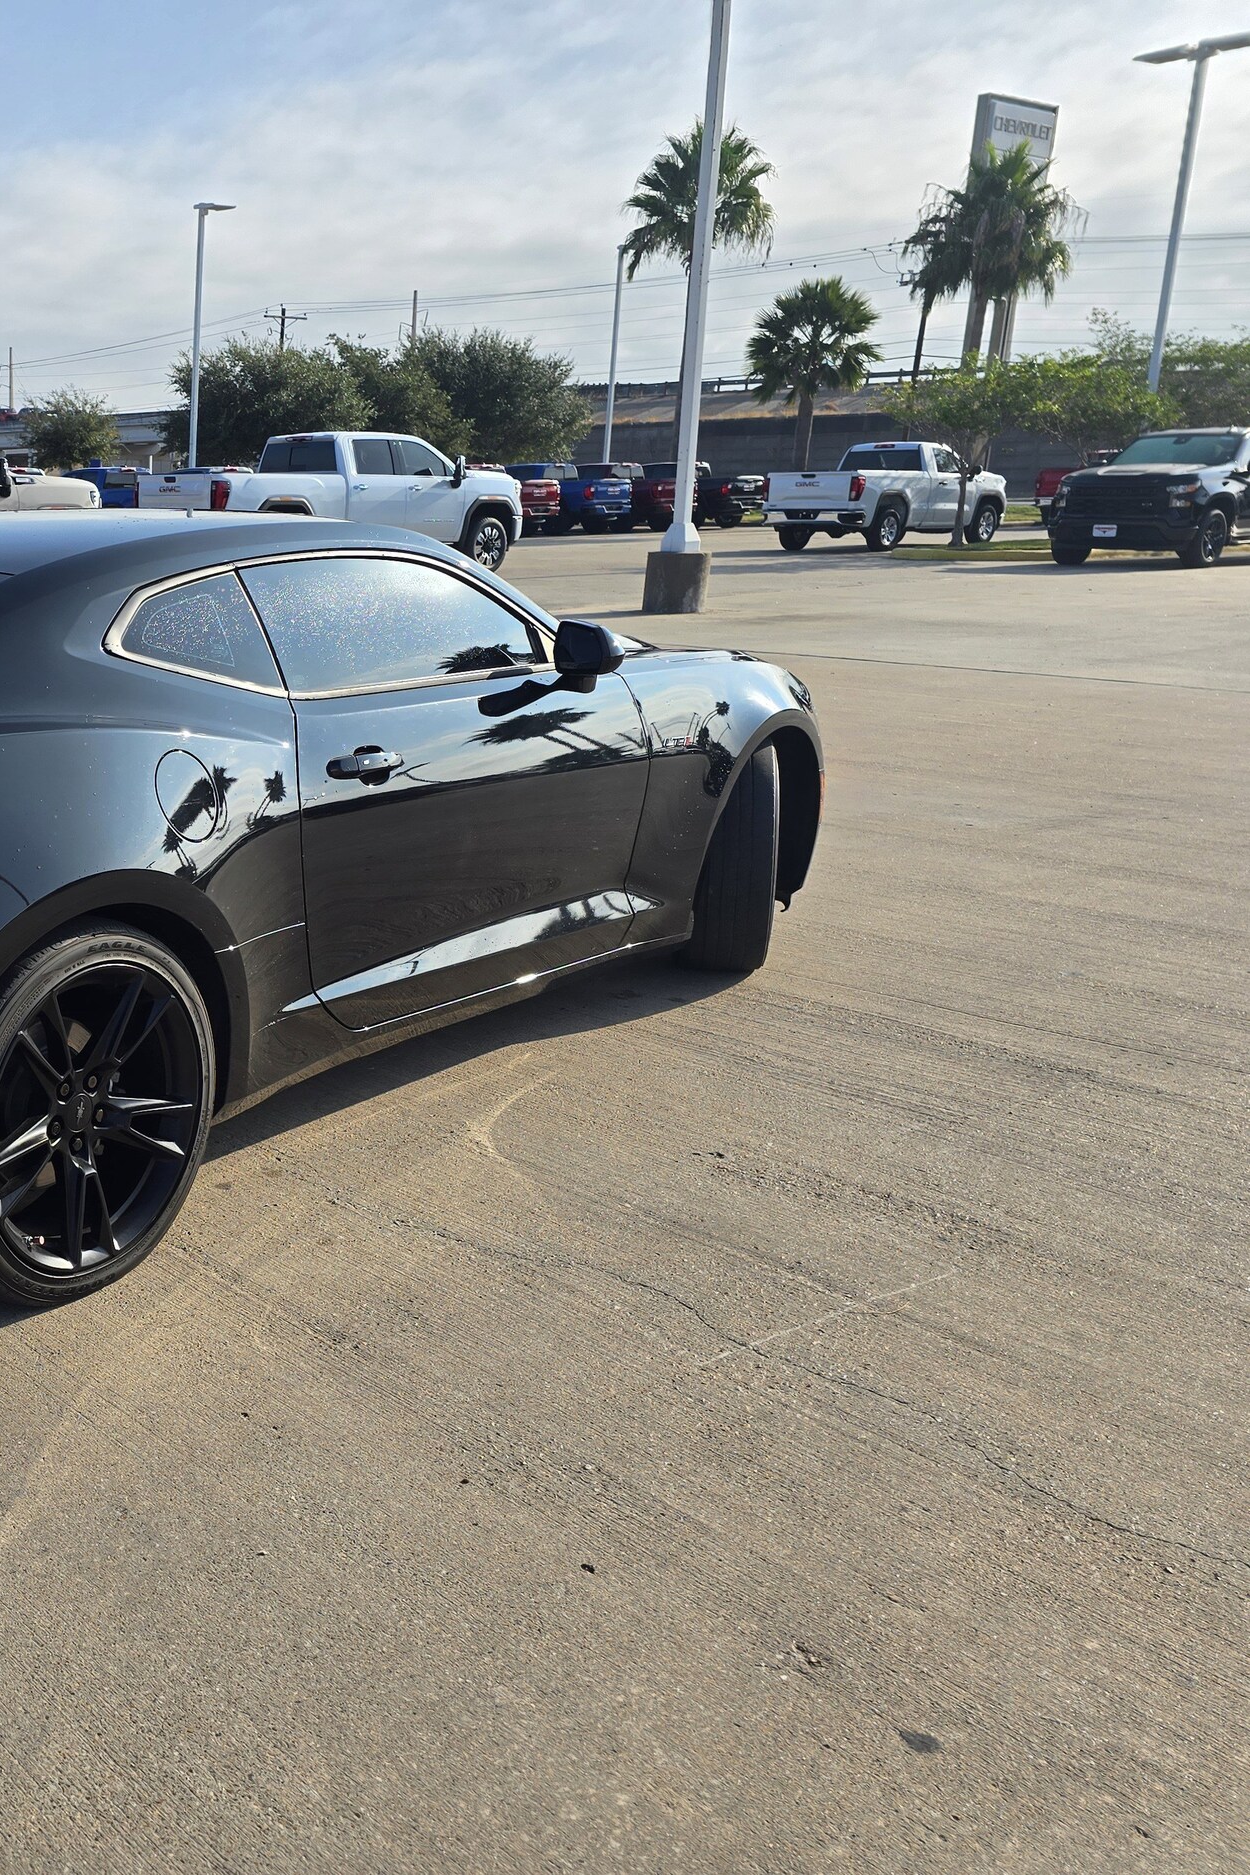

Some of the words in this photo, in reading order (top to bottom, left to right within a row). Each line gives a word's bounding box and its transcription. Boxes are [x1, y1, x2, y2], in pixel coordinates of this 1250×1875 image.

[994, 116, 1052, 140] CHEVROLET
[159, 485, 181, 493] GMC
[86, 941, 147, 954] EAGLE
